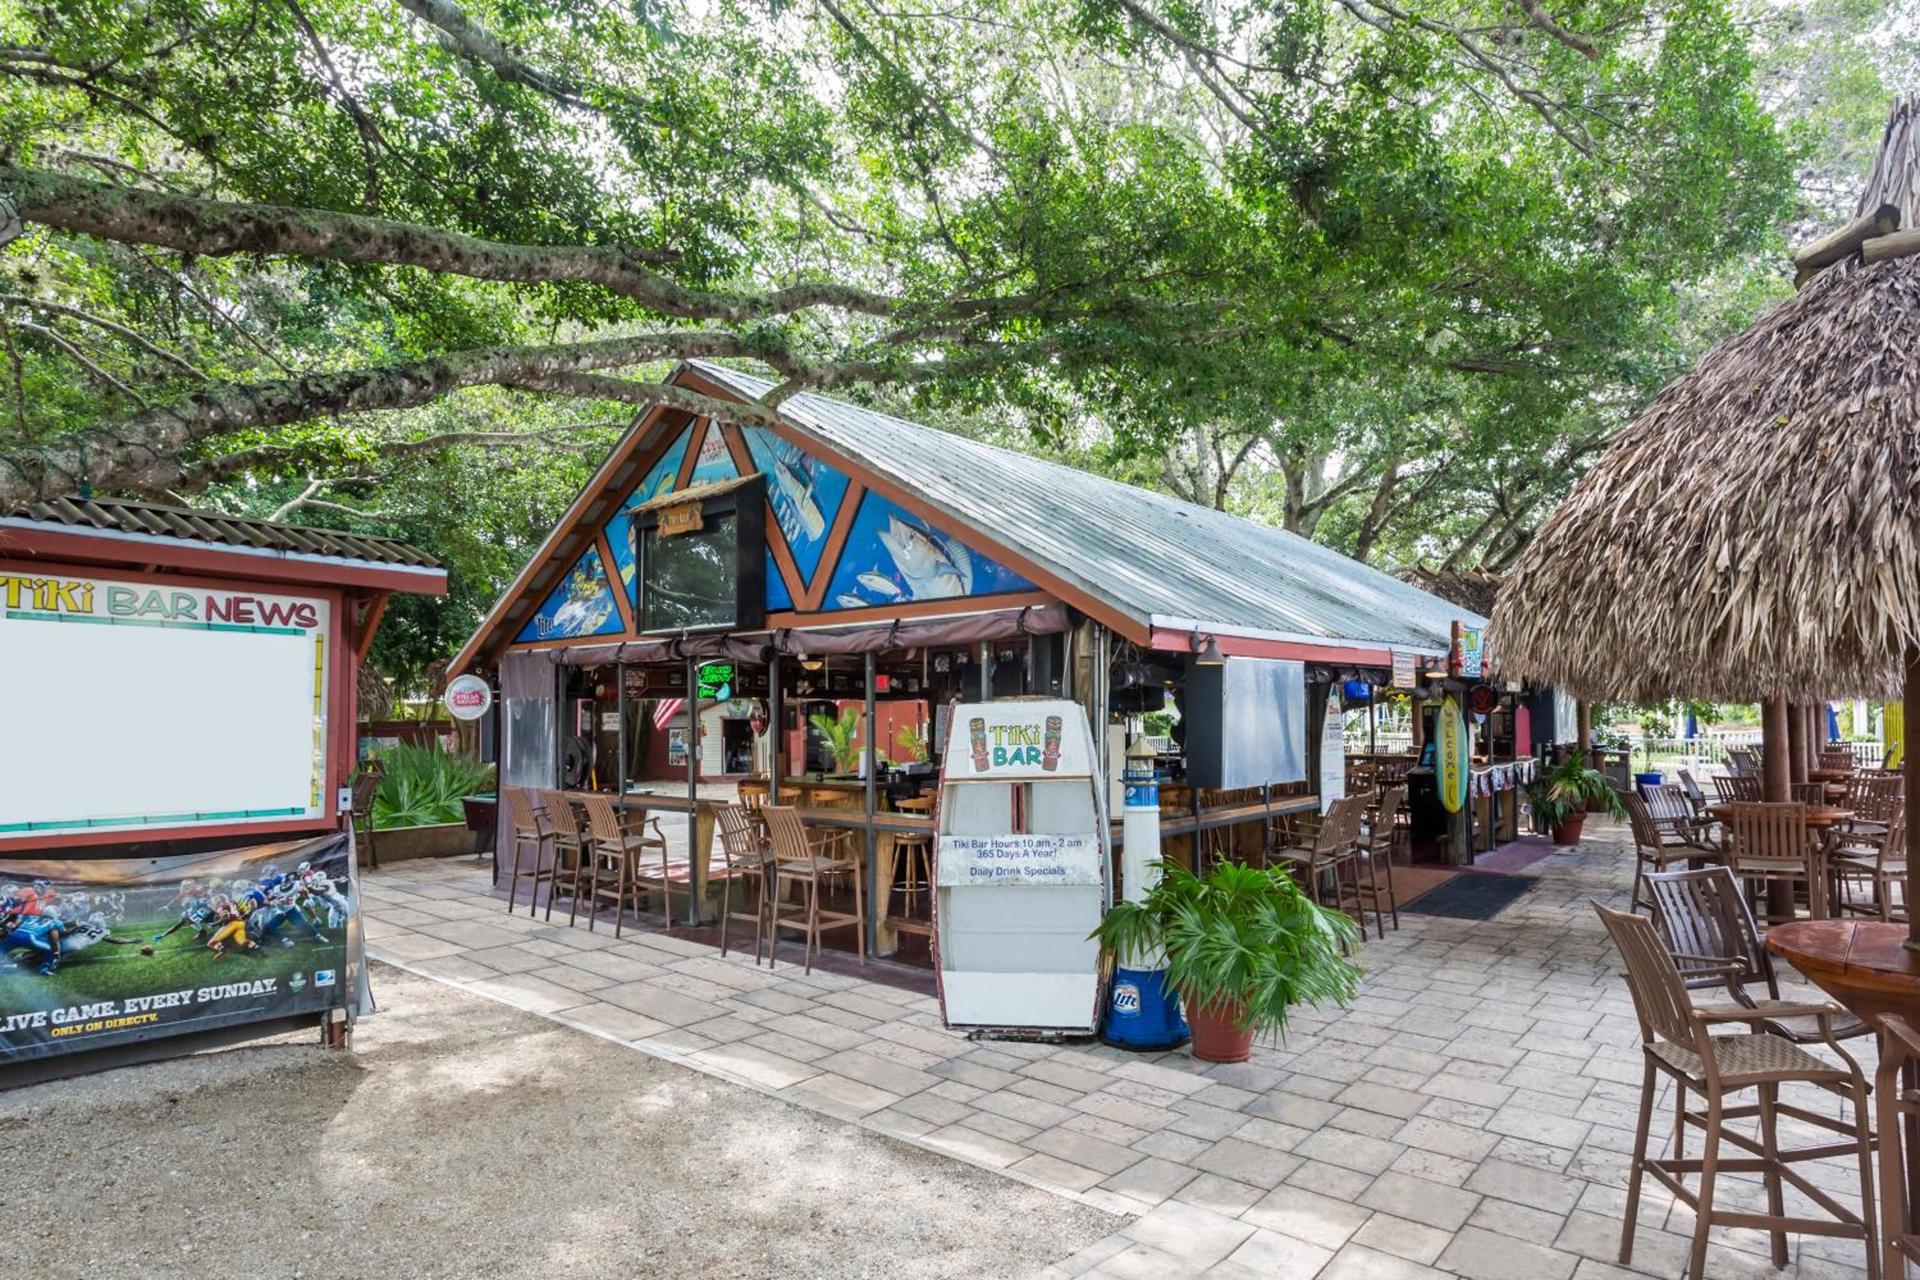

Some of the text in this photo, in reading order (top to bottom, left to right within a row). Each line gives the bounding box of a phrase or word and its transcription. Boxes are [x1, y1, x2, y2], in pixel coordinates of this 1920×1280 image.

[107, 586, 198, 621] BAR
[205, 595, 319, 629] NEWS
[993, 746, 1042, 767] BAR
[953, 839, 969, 848] Tiki
[971, 839, 988, 849] Bar
[1023, 838, 1034, 848] 10
[1036, 840, 1051, 848] am
[1058, 838, 1065, 848] 2
[1066, 840, 1083, 848] am
[976, 849, 994, 859] 365
[996, 849, 1020, 860] Days
[1022, 849, 1030, 858] A
[970, 865, 1066, 879] Daily Drink Specials
[51, 1000, 120, 1025] GAME.
[124, 990, 194, 1013] EVERY
[197, 977, 278, 1003] SUNDAY.
[51, 1013, 158, 1037] ONLY ON DIRECTV.
